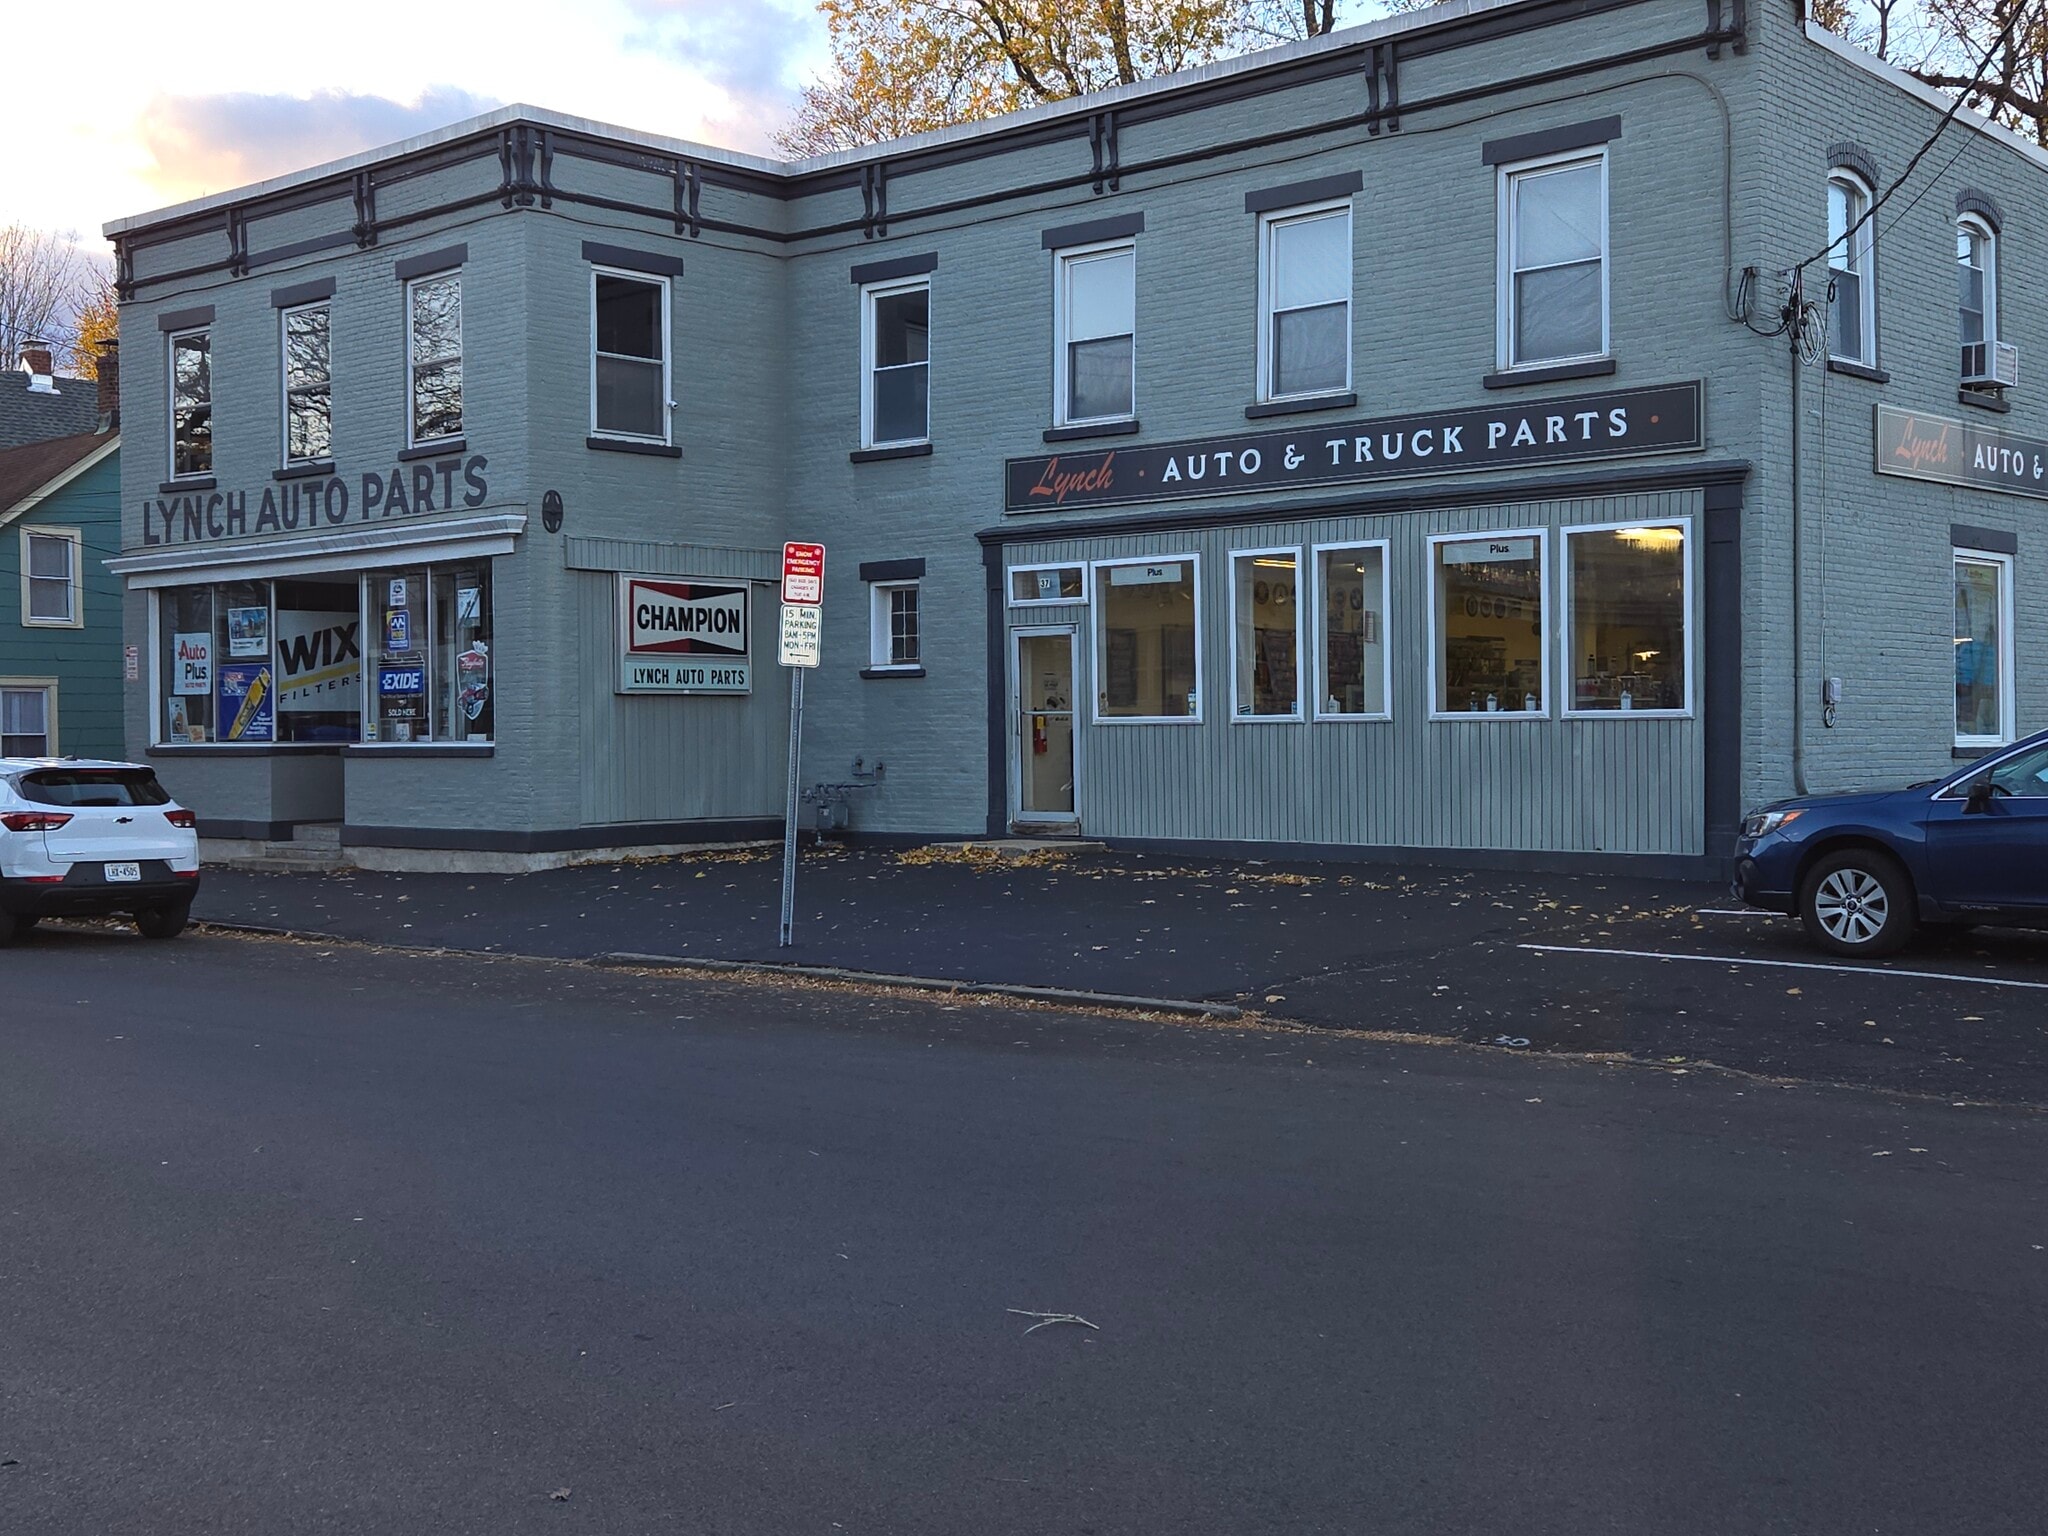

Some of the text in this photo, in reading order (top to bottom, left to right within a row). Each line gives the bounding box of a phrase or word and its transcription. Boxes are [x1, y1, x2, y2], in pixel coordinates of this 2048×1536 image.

[1029, 407, 1628, 504] Lynch AUTO & TRUCK PARTS
[1895, 416, 2044, 480] Lynch AUTO &
[144, 455, 489, 545] LYNCH AUTO PARTS
[1490, 543, 1509, 554] Plus
[1147, 568, 1163, 577] Plus
[1040, 579, 1049, 588] 37
[637, 603, 740, 634] CHAMPION
[785, 609, 794, 618] 15
[784, 620, 816, 630] PARKING
[178, 640, 207, 660] Auto
[278, 621, 360, 676] WIX
[382, 672, 420, 690] EXIDE
[634, 668, 745, 685] LYNCH AUTO PARTS
[279, 673, 361, 704] FILTERS
